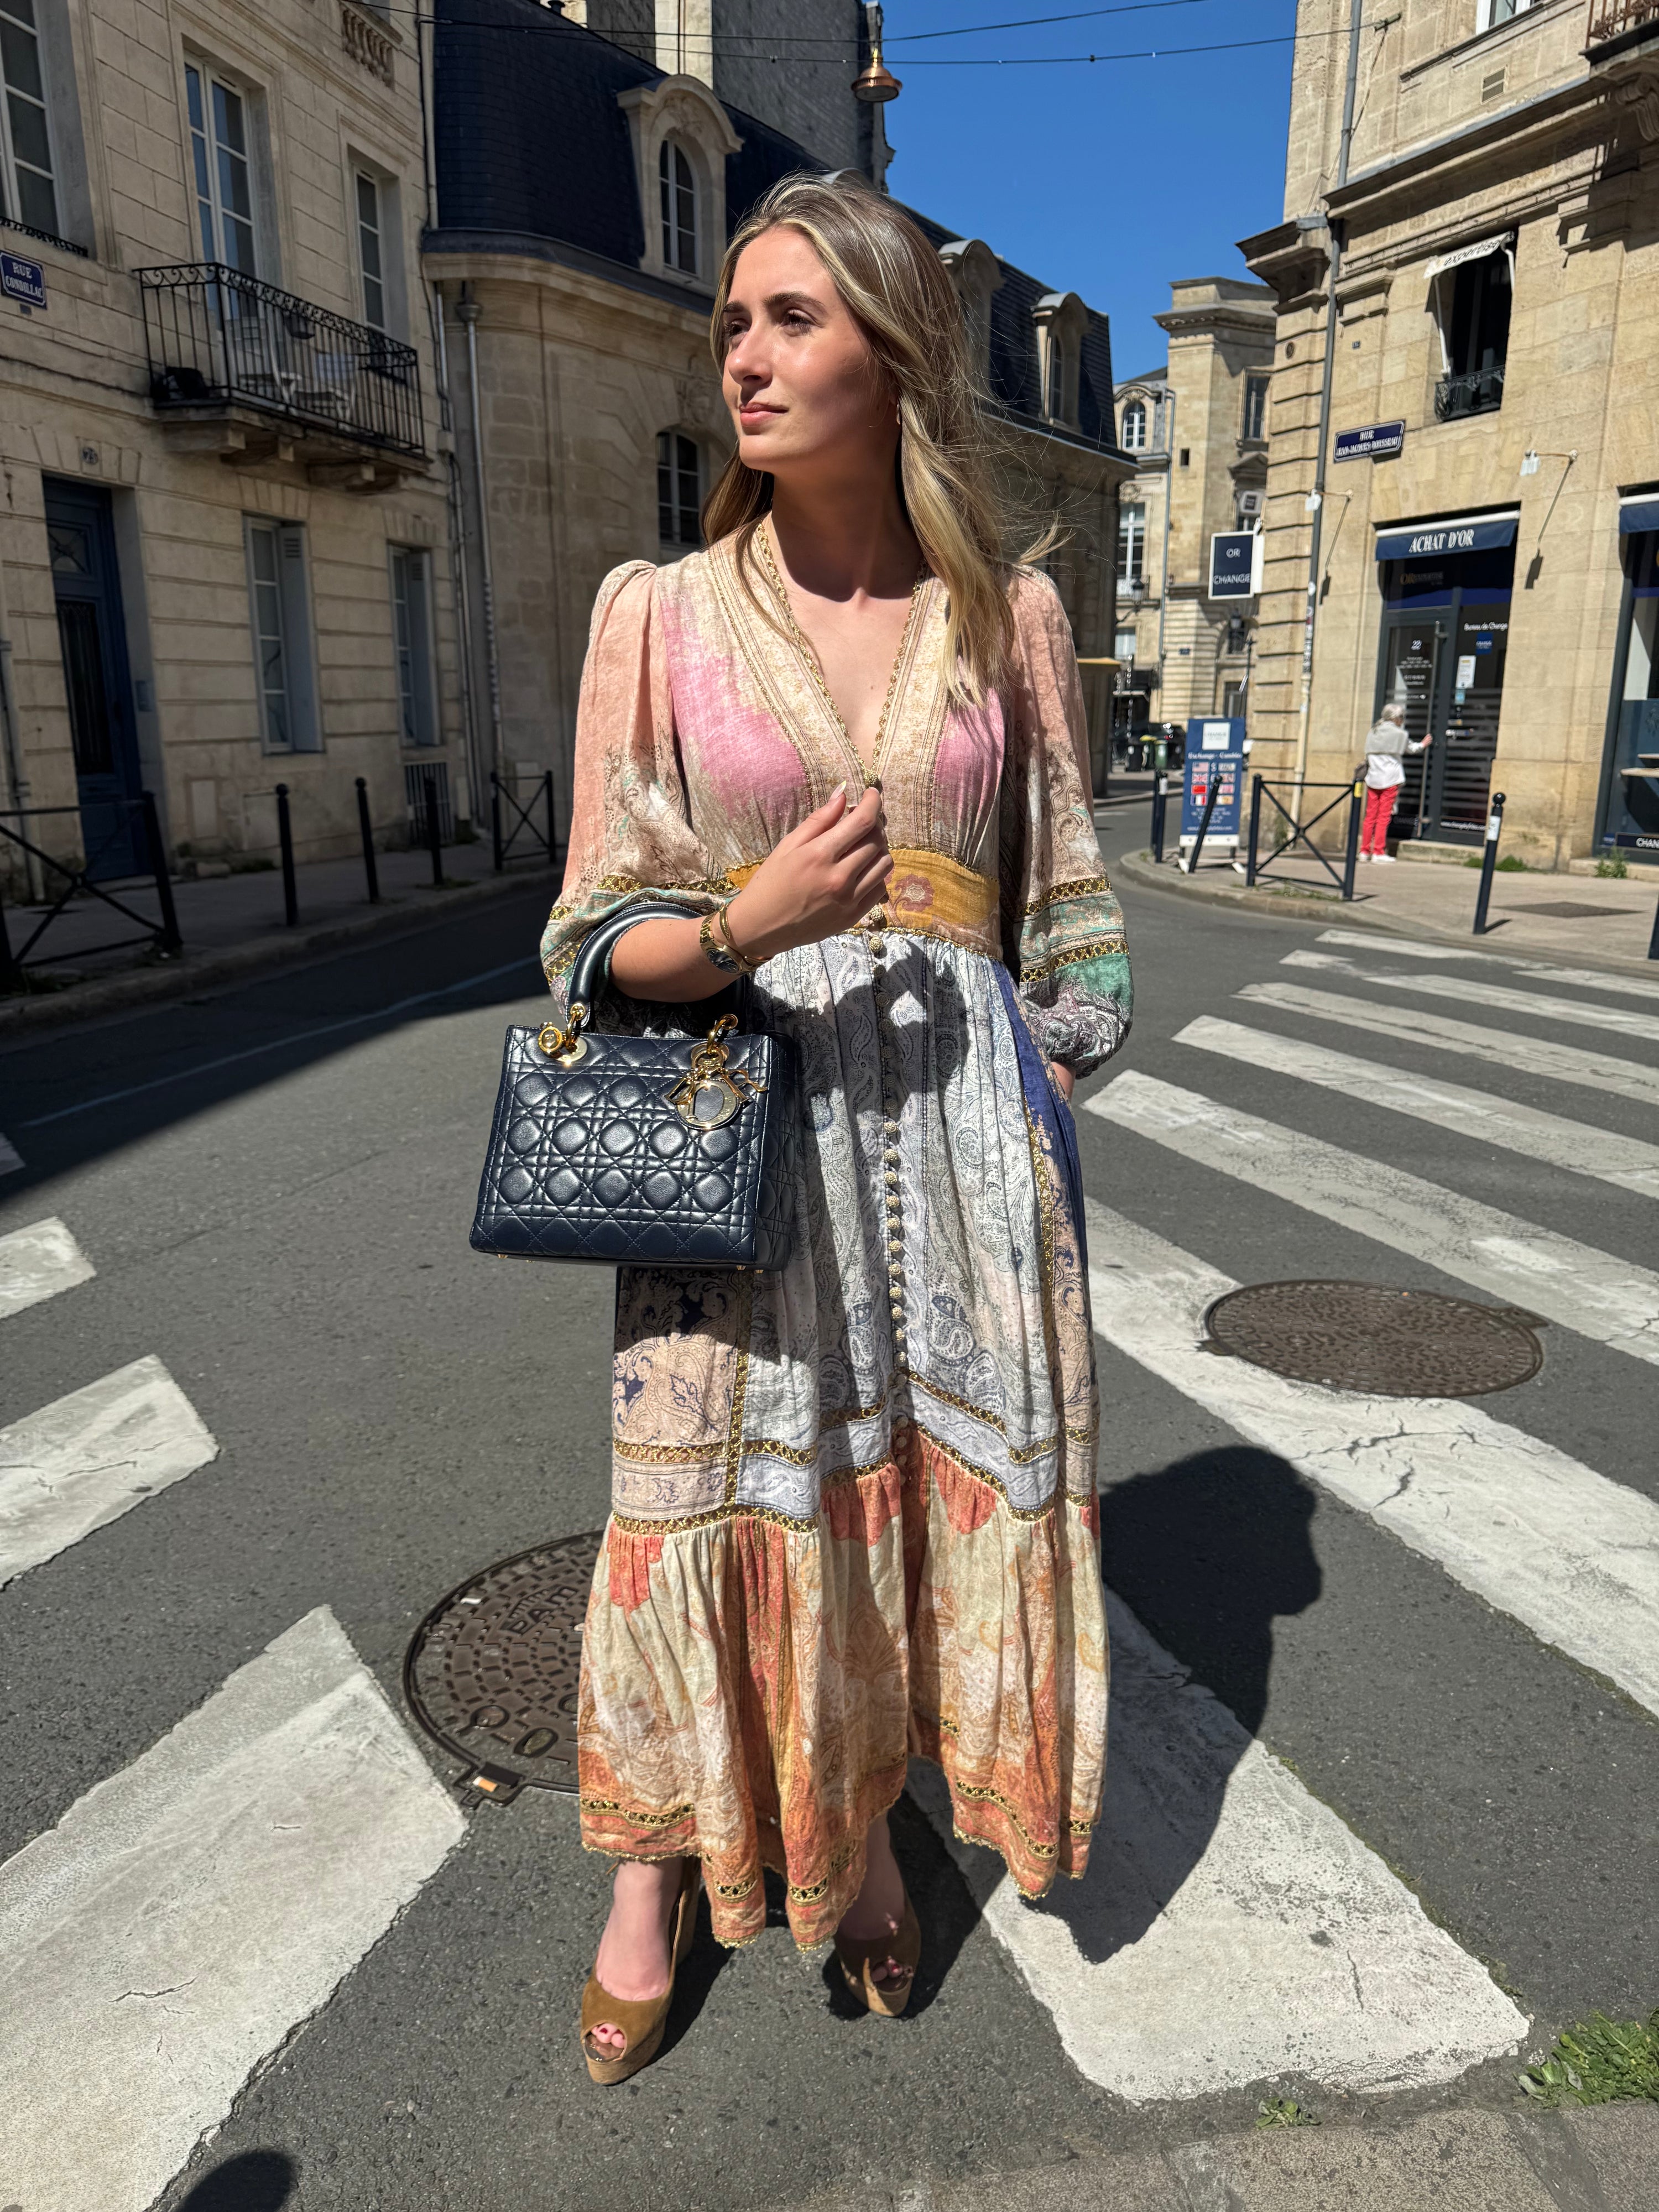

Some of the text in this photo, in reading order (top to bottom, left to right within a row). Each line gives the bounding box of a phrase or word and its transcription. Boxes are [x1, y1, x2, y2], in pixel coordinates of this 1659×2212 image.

[12, 262, 32, 279] RUE
[5, 275, 43, 299] CONDILLAC
[1359, 430, 1375, 442] RUE
[1408, 529, 1475, 552] ACHAT D'OR
[1226, 548, 1241, 559] OR
[1213, 573, 1251, 585] CHANGE
[1464, 623, 1481, 631] Bureau
[1489, 622, 1509, 631] Change
[1411, 639, 1422, 650] 22
